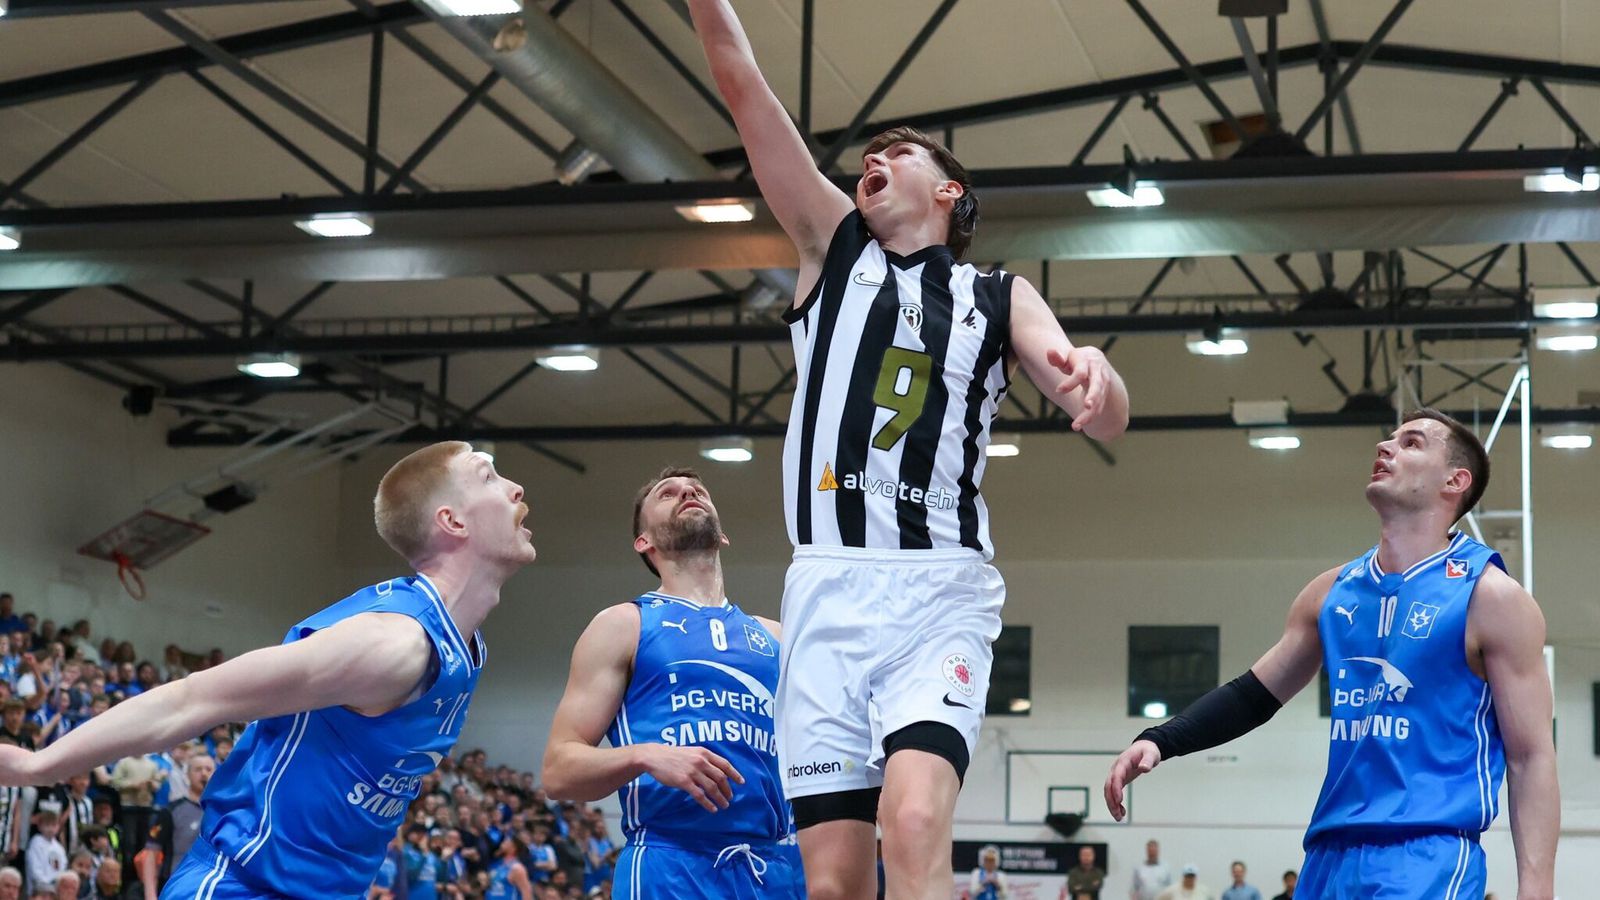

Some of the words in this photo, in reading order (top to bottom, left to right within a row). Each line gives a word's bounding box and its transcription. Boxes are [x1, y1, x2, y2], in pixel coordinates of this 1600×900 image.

[872, 345, 933, 452] 9
[843, 470, 955, 510] alvotech
[709, 618, 729, 651] 8
[1377, 595, 1398, 638] 10
[347, 782, 404, 818] SAM
